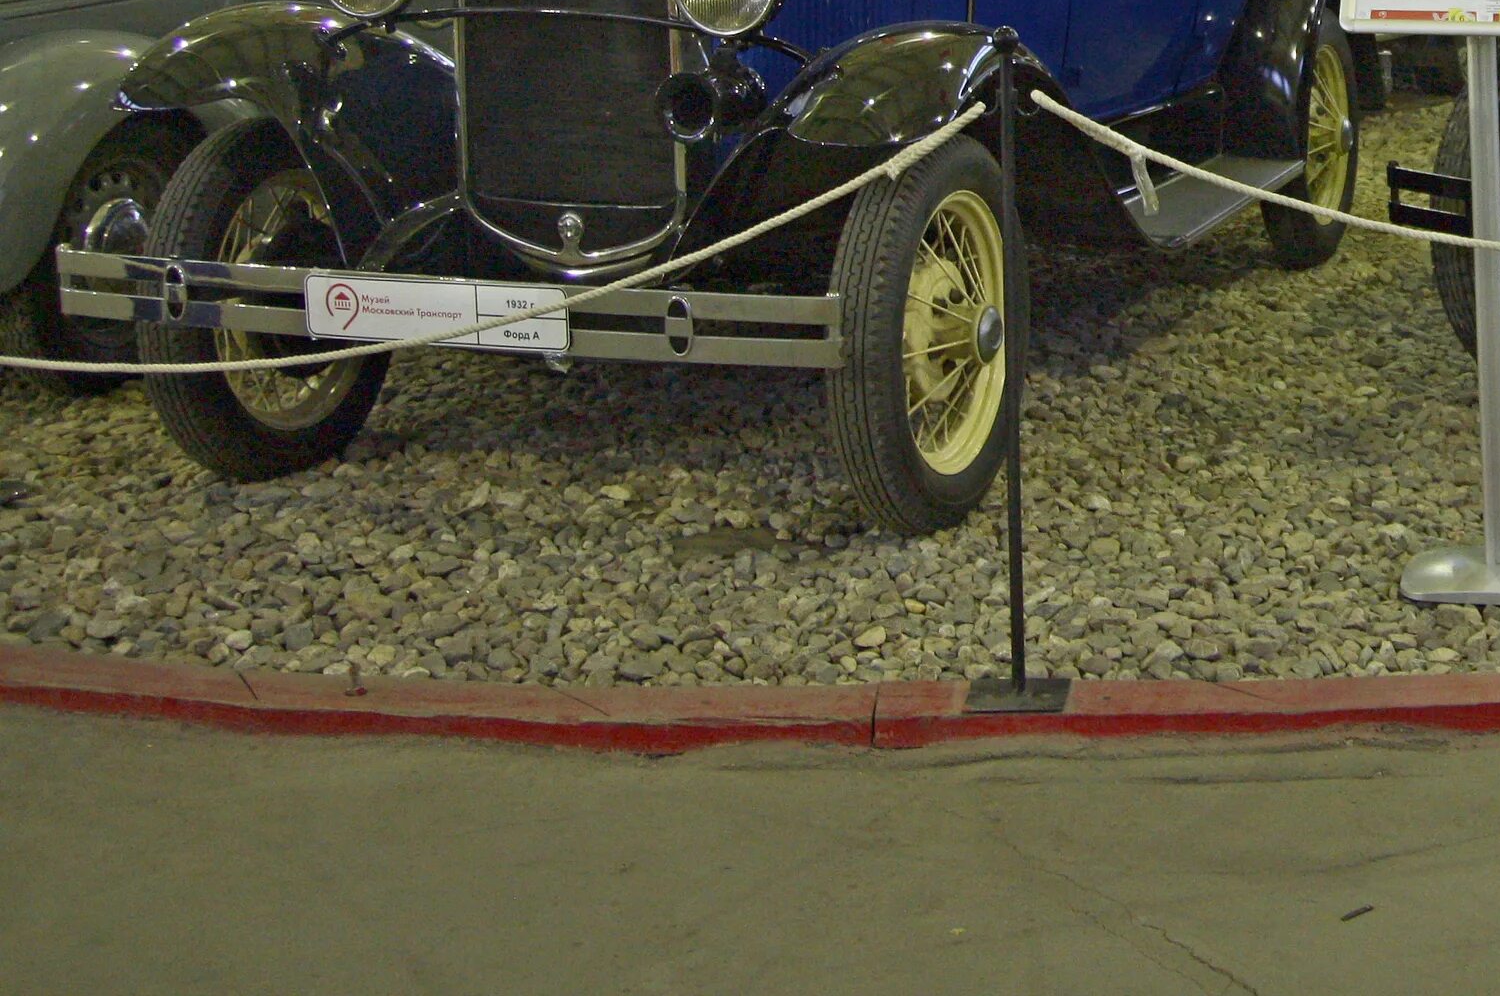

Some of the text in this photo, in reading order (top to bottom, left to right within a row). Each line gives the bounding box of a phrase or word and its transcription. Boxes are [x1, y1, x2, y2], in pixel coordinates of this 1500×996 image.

[361, 294, 390, 305] Музей
[506, 299, 528, 309] 1932
[362, 306, 463, 321] Московский Транспорт
[503, 329, 541, 341] Форд А
